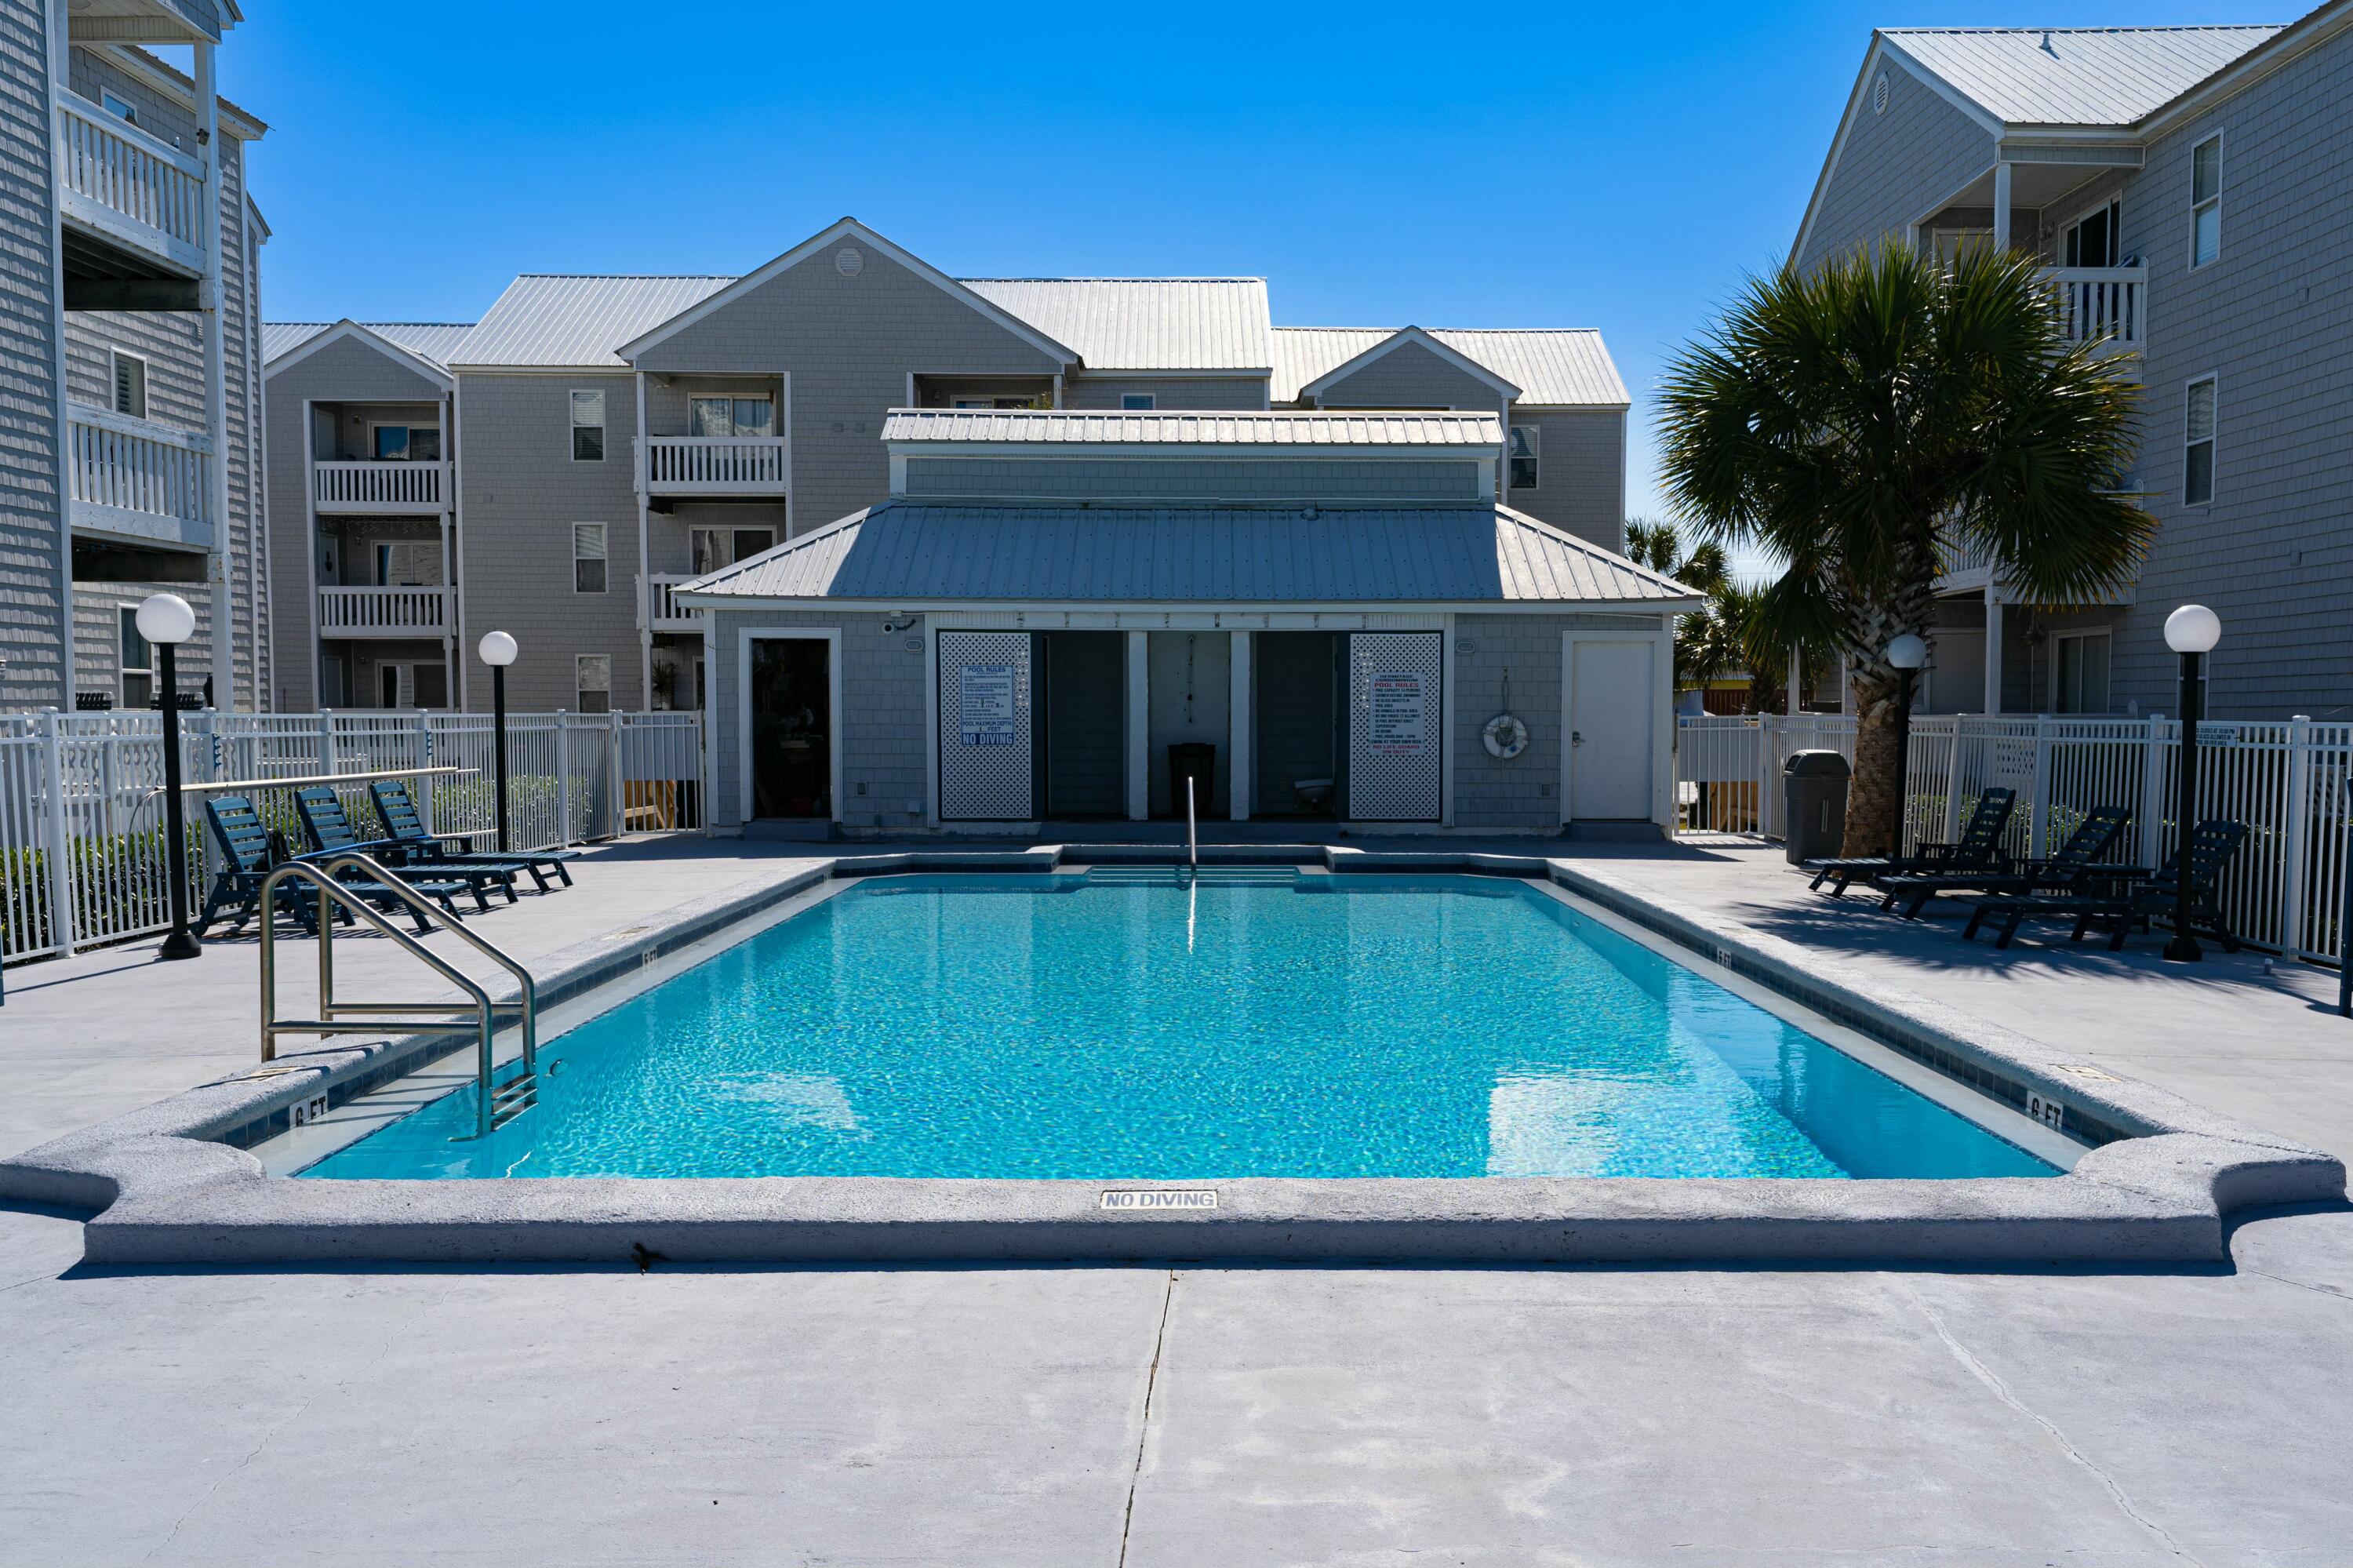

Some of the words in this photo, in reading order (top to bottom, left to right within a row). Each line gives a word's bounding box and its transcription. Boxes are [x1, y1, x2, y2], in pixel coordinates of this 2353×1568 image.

[963, 734, 976, 744] NO
[980, 734, 1012, 744] DIVING
[650, 949, 656, 962] FT
[296, 1107, 304, 1126] 6
[310, 1095, 326, 1120] FT
[2032, 1097, 2040, 1116] 6
[2045, 1103, 2061, 1125] FT
[1106, 1193, 1134, 1207] NO
[1140, 1193, 1214, 1206] DIVING
